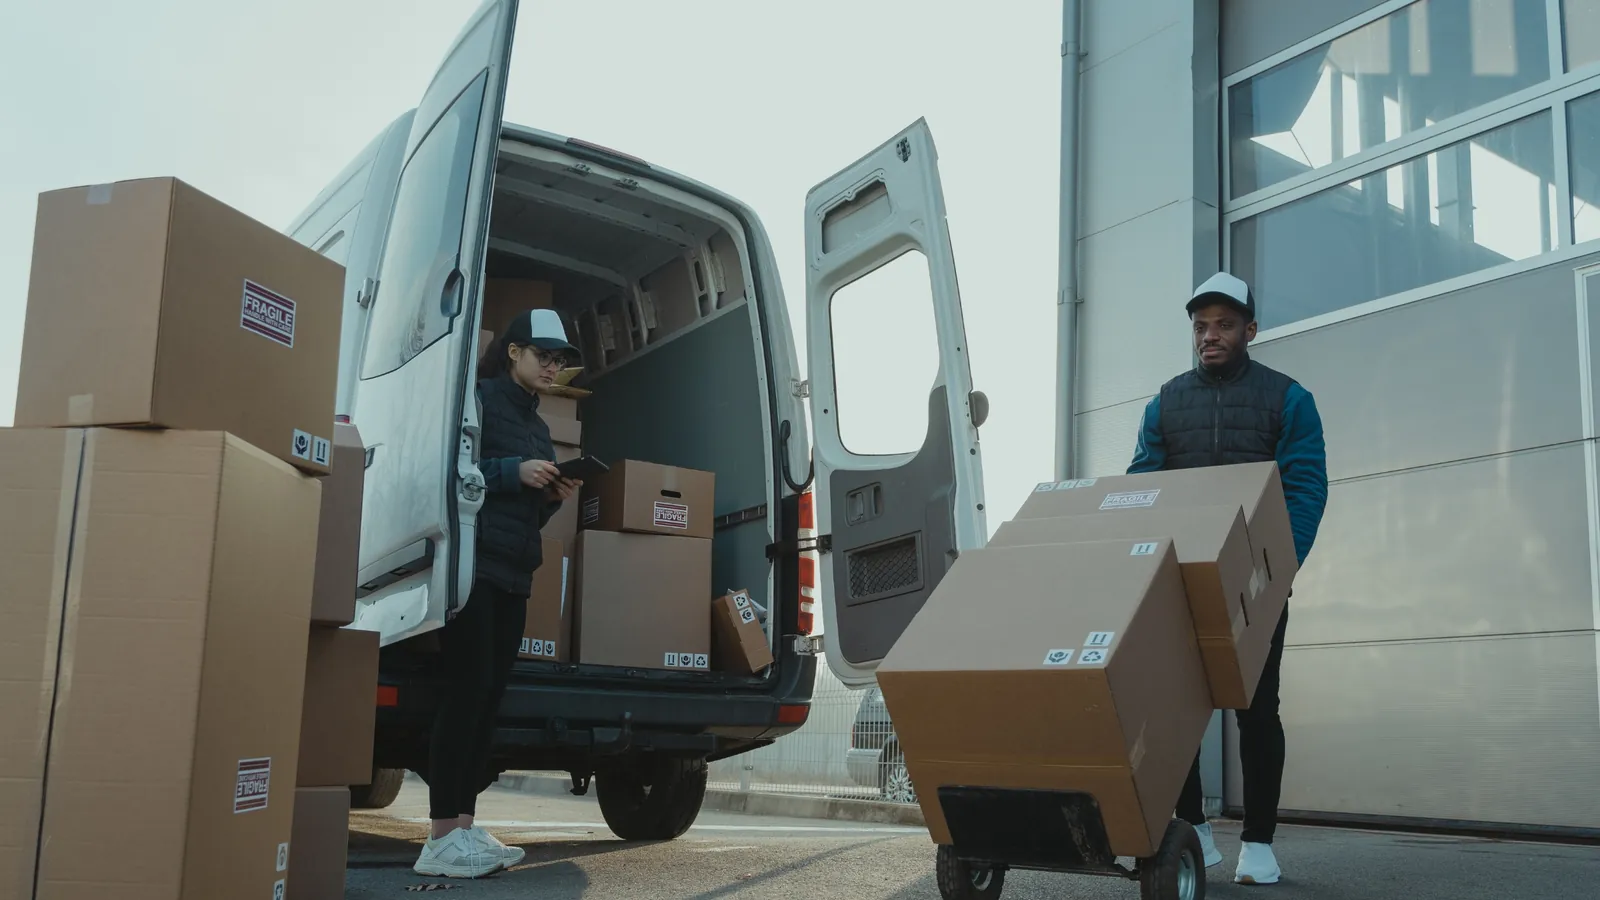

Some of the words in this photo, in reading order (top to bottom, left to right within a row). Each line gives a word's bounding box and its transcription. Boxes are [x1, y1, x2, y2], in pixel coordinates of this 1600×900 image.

[245, 295, 292, 327] FRAGILE
[1104, 494, 1153, 504] FRAGILE
[656, 511, 687, 521] FRAGILE
[238, 779, 268, 796] FRAGILE
